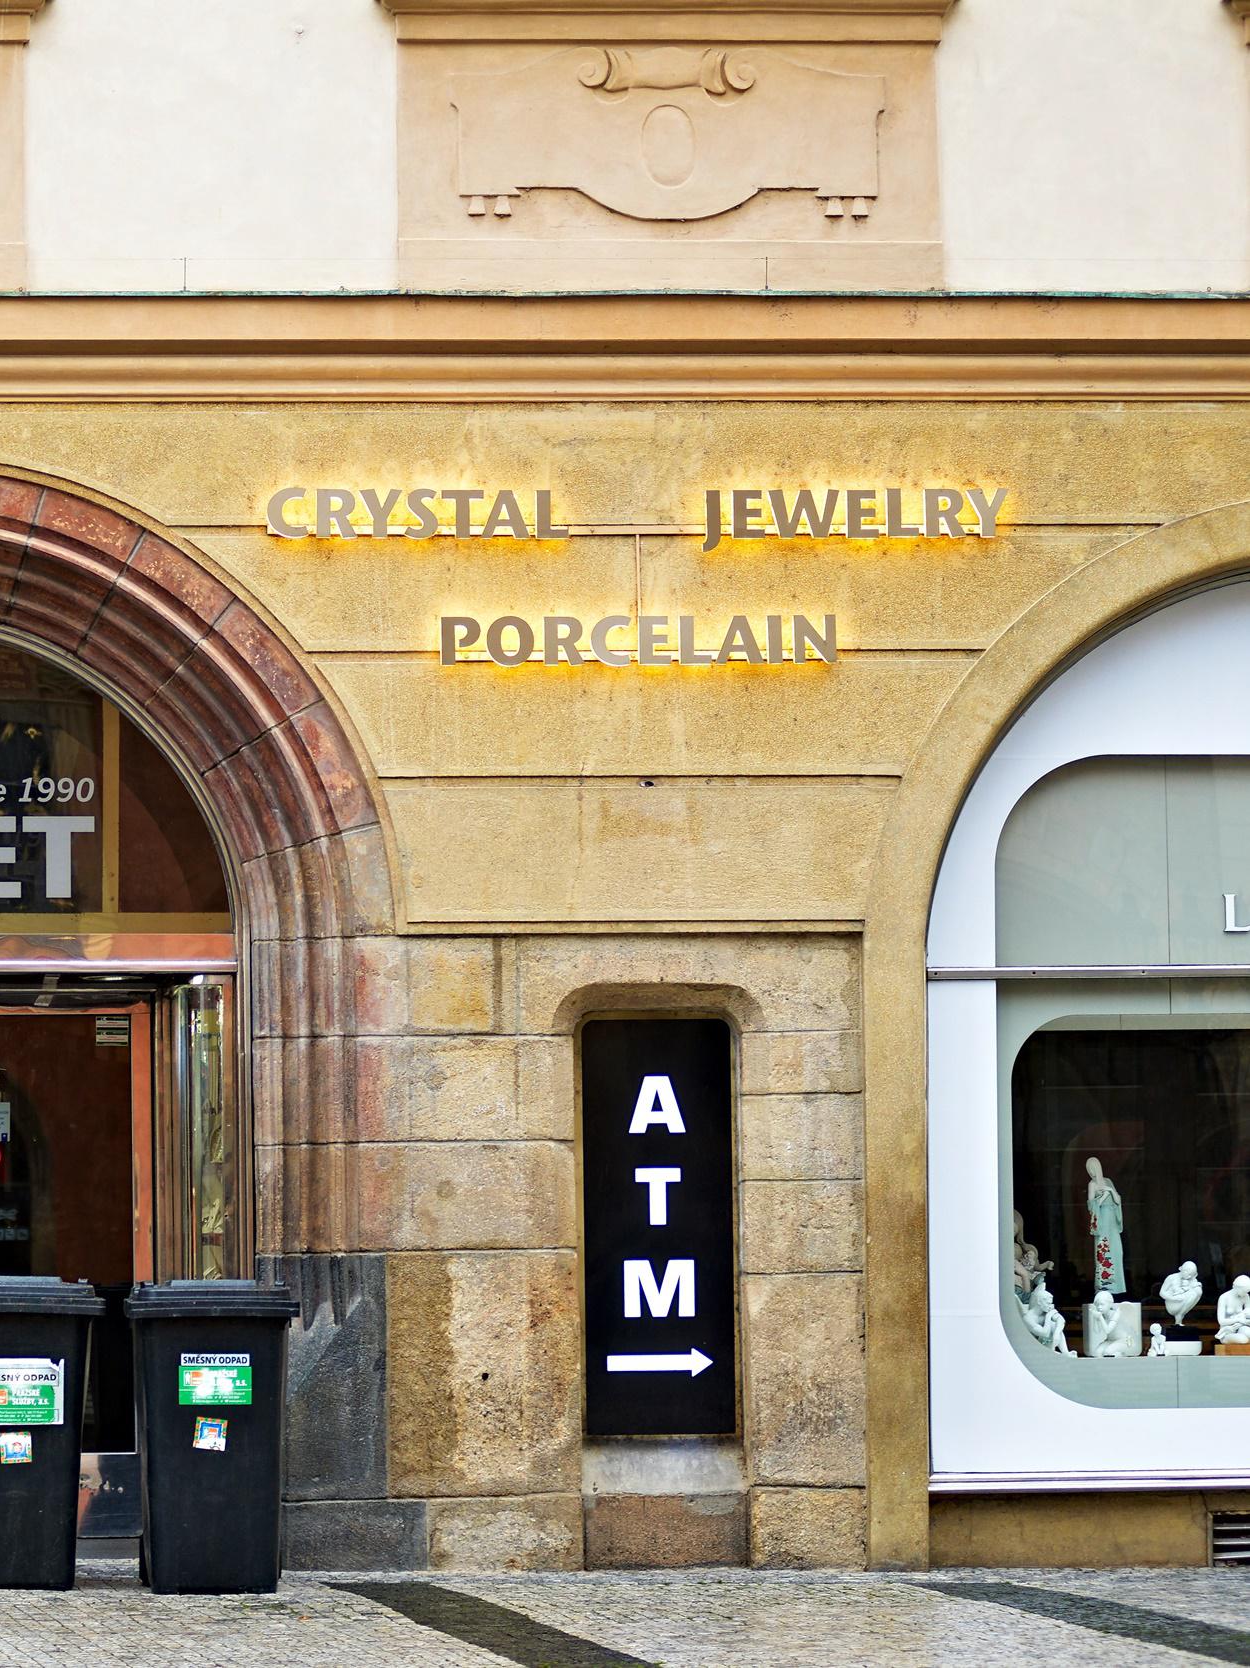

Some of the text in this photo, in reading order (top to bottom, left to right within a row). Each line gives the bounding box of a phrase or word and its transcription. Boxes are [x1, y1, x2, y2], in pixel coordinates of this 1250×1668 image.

[267, 487, 1008, 552] CRYSTAL JEWELRY
[440, 614, 837, 666] PORCELAIN
[20, 777, 95, 803] 1990
[623, 1075, 695, 1318] ATM
[183, 1354, 248, 1364] SMĚSNÝ ODPAD
